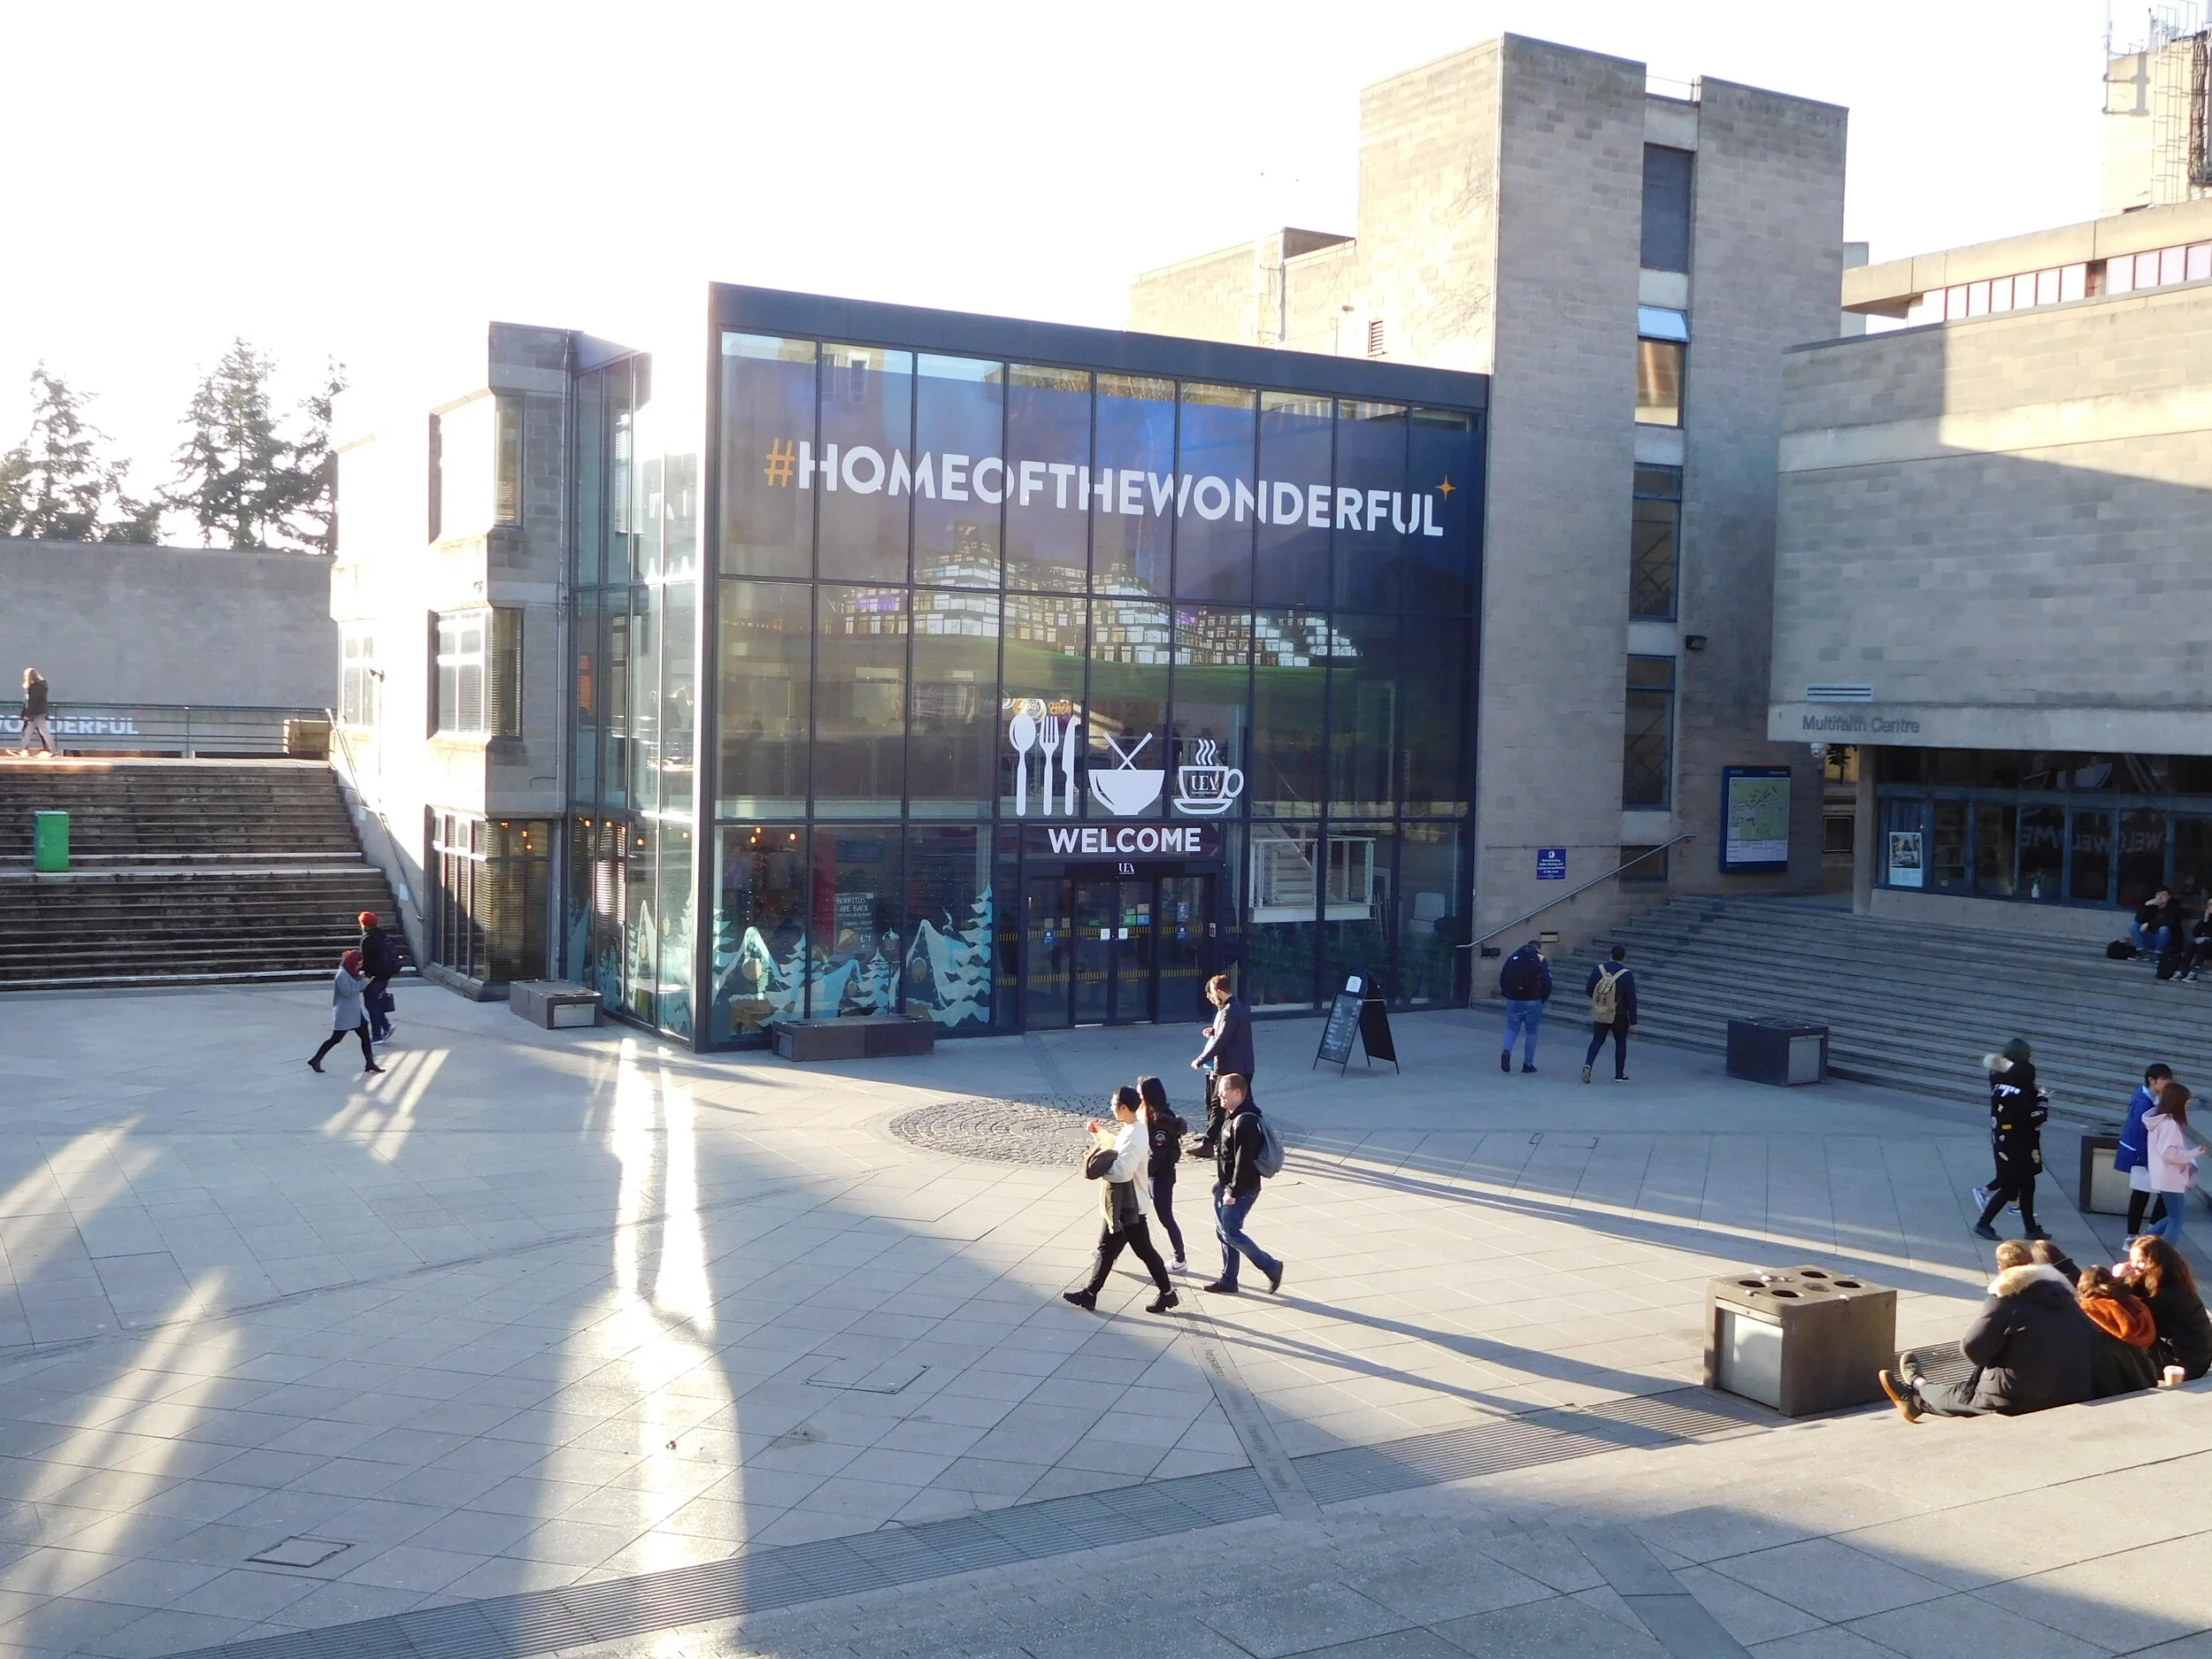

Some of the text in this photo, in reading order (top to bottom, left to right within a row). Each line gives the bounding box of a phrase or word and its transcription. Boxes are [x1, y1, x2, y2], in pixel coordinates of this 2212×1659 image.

[764, 438, 1445, 537] #HOMEOFTHEWONDERFUL
[0, 715, 139, 734] ODERFUL
[1802, 715, 1920, 733] Multifaith Centre
[1048, 827, 1202, 854] WELCOME
